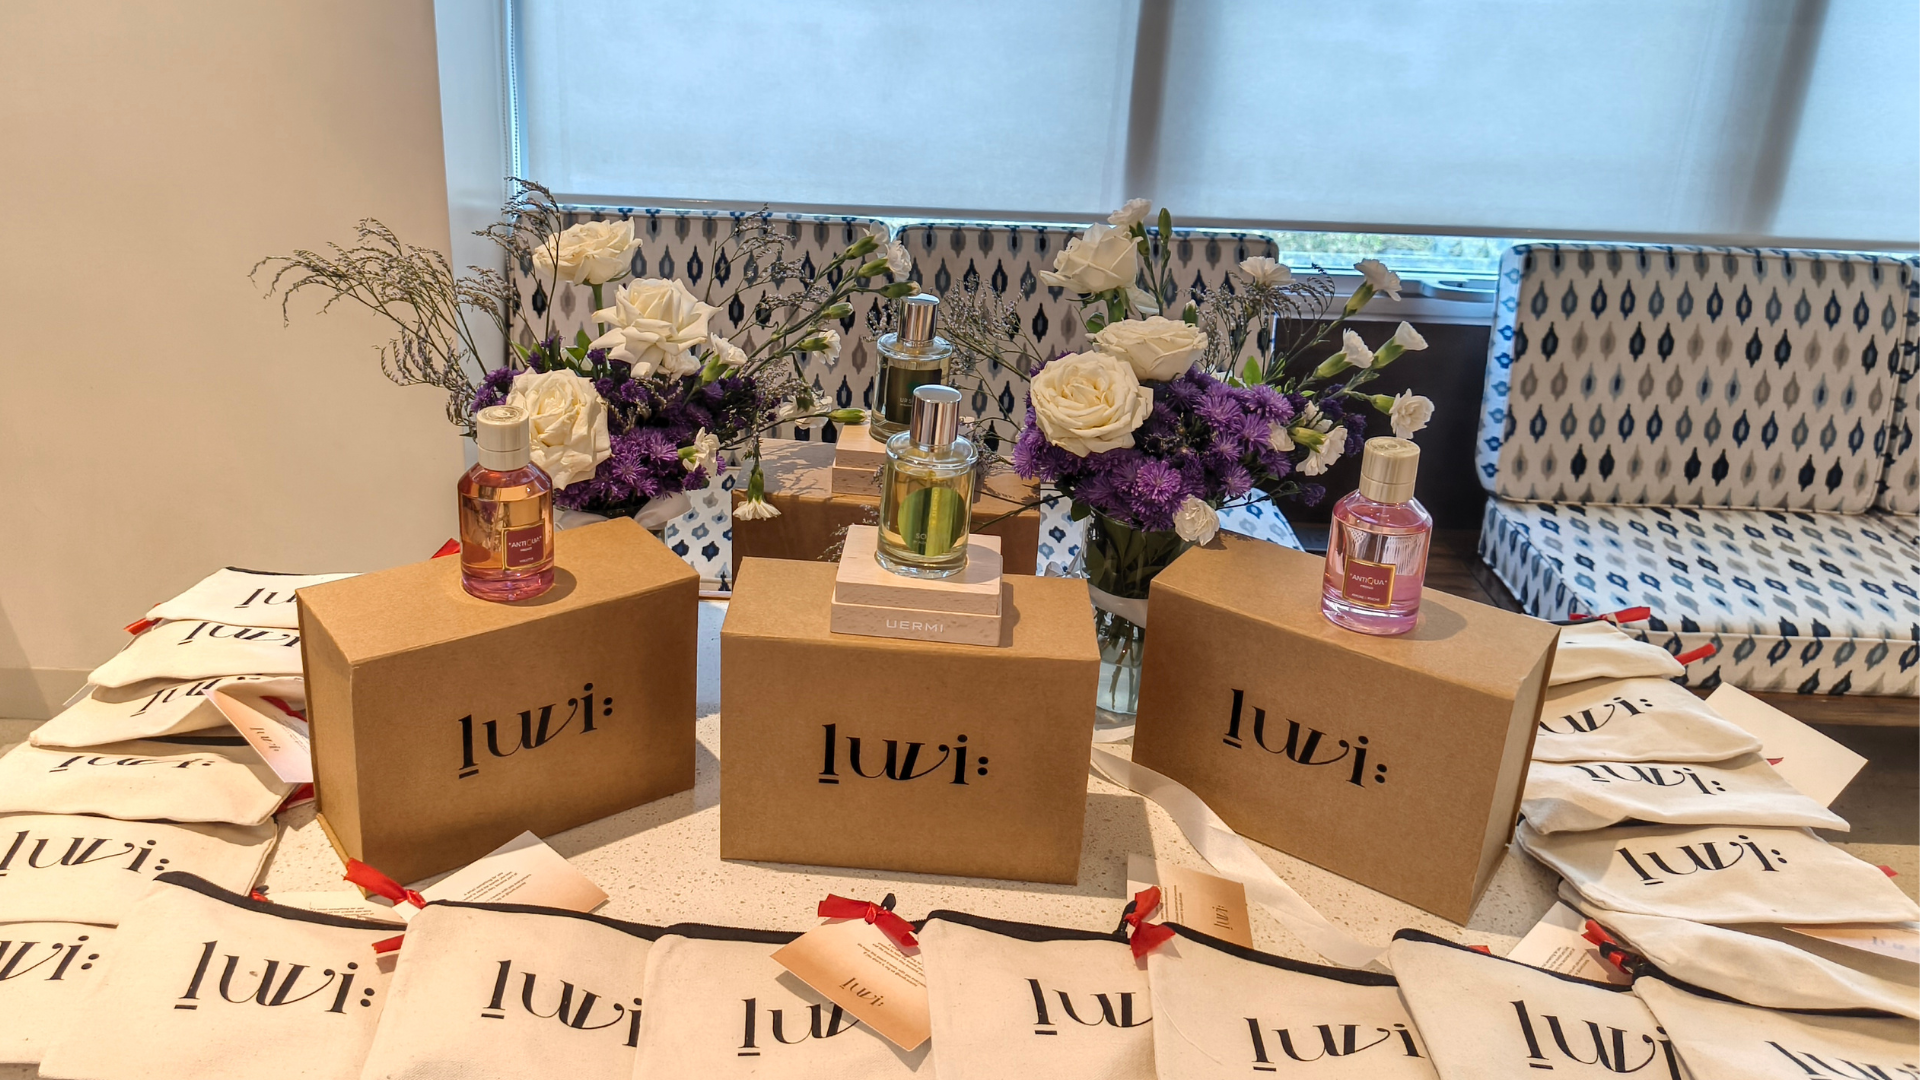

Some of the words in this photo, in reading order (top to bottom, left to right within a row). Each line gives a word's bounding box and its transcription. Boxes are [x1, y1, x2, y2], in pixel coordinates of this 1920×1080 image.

[886, 619, 944, 633] UERMI
[481, 959, 642, 1048] luvi
[1243, 1016, 1426, 1072] luvi
[1510, 999, 1683, 1080] luvi
